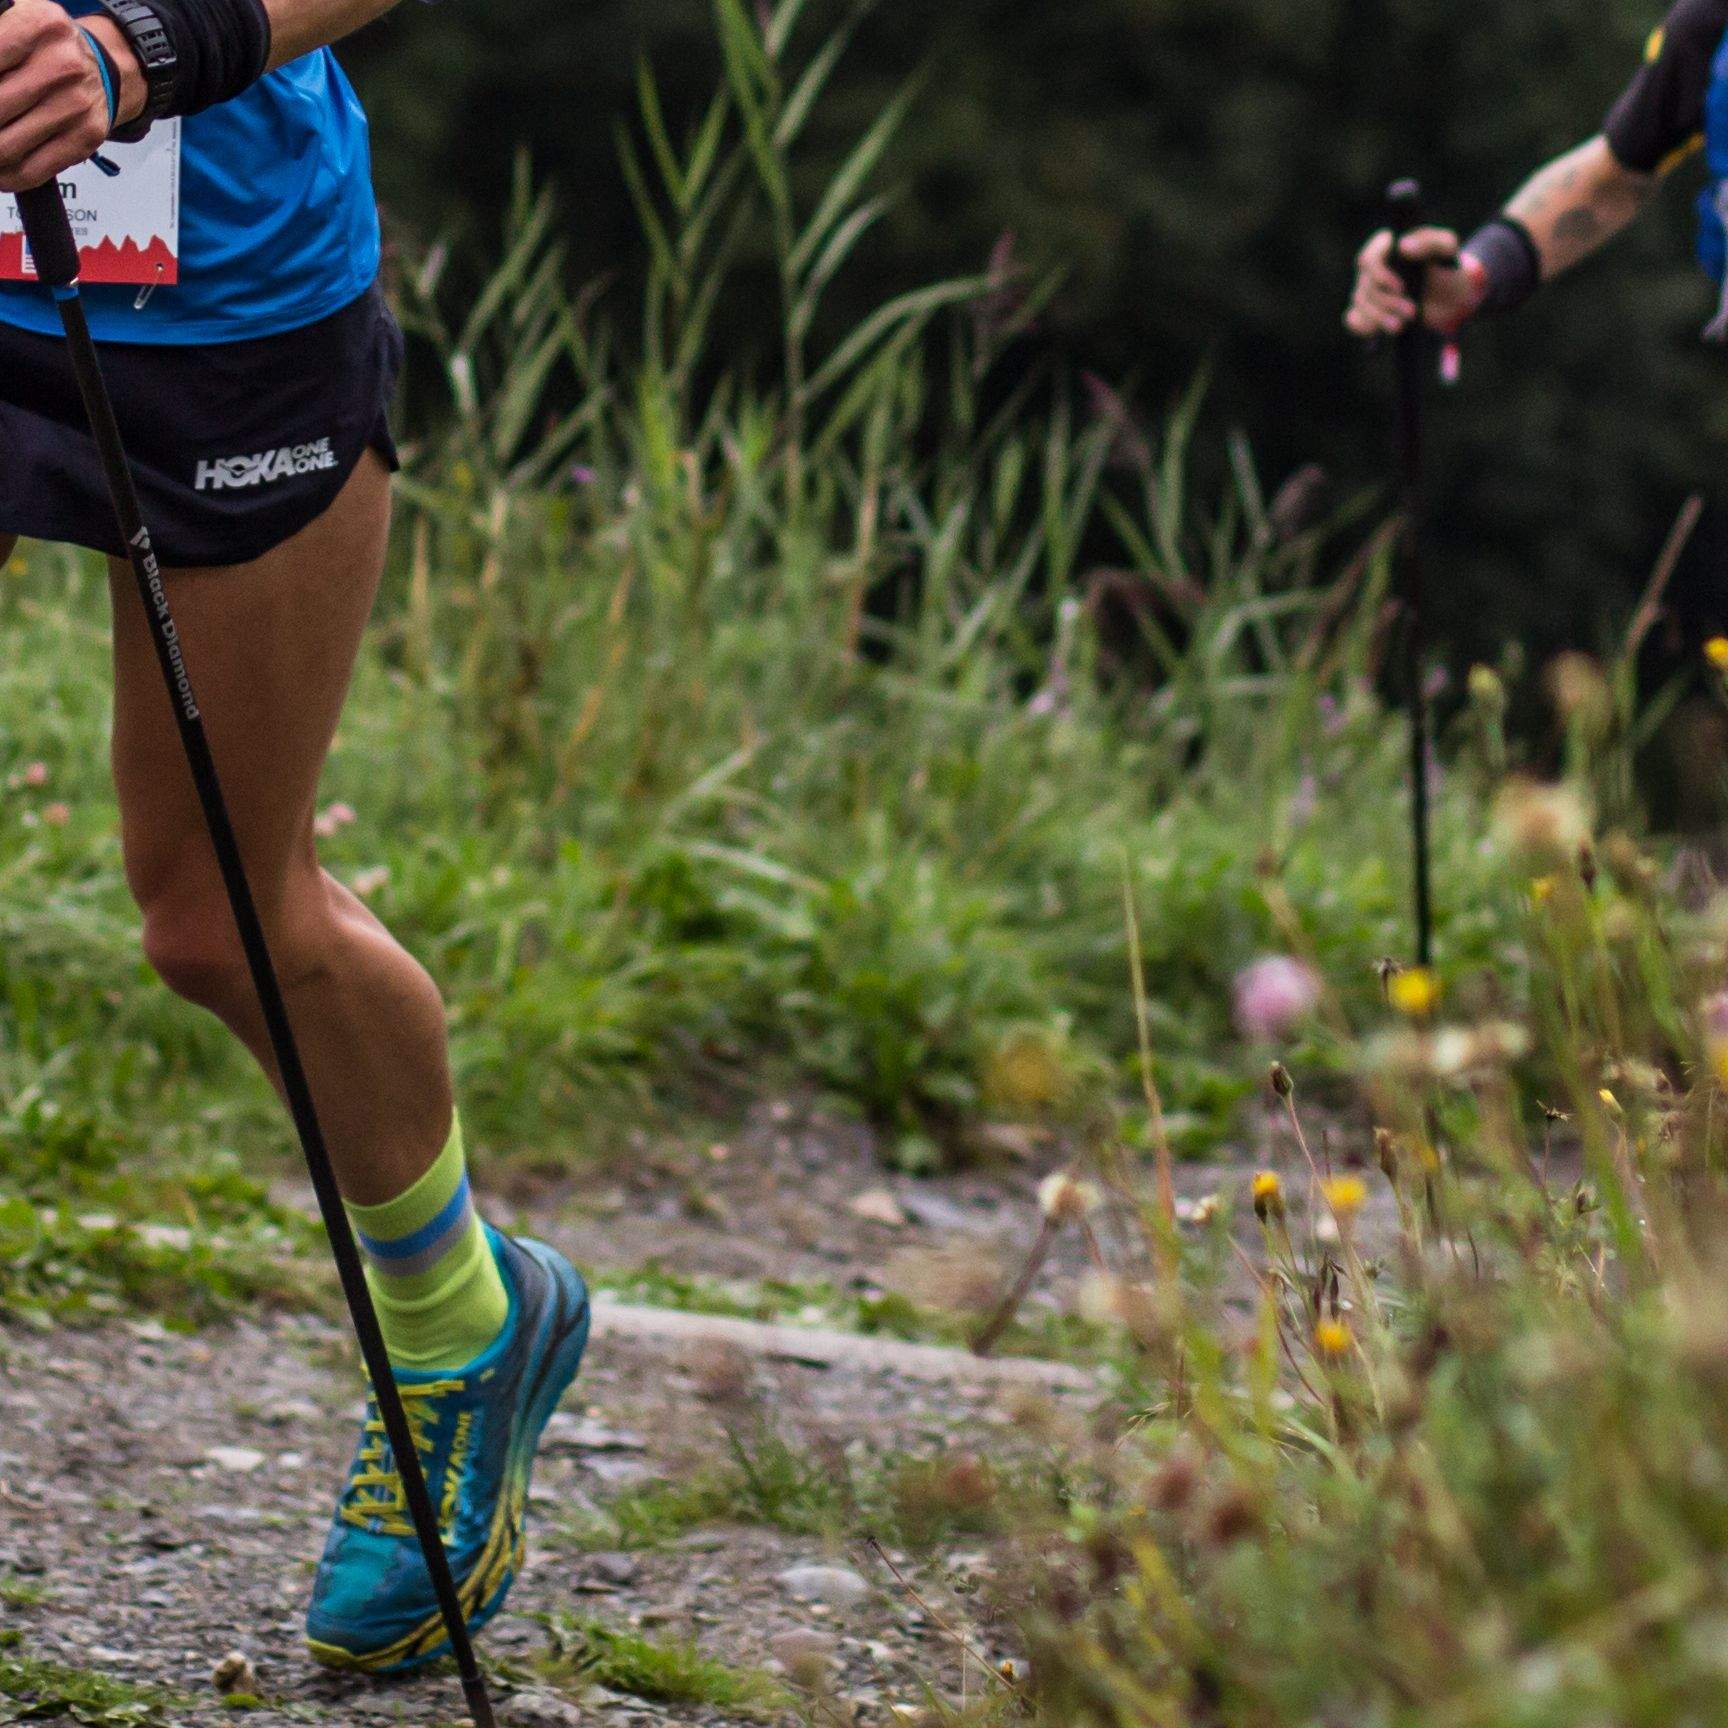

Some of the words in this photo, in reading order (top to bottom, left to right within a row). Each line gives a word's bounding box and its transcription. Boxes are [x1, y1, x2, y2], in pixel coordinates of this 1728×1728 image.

[194, 446, 297, 491] HOKA
[291, 435, 331, 460] ONE
[141, 552, 170, 621] Black
[161, 618, 201, 722] Diamond
